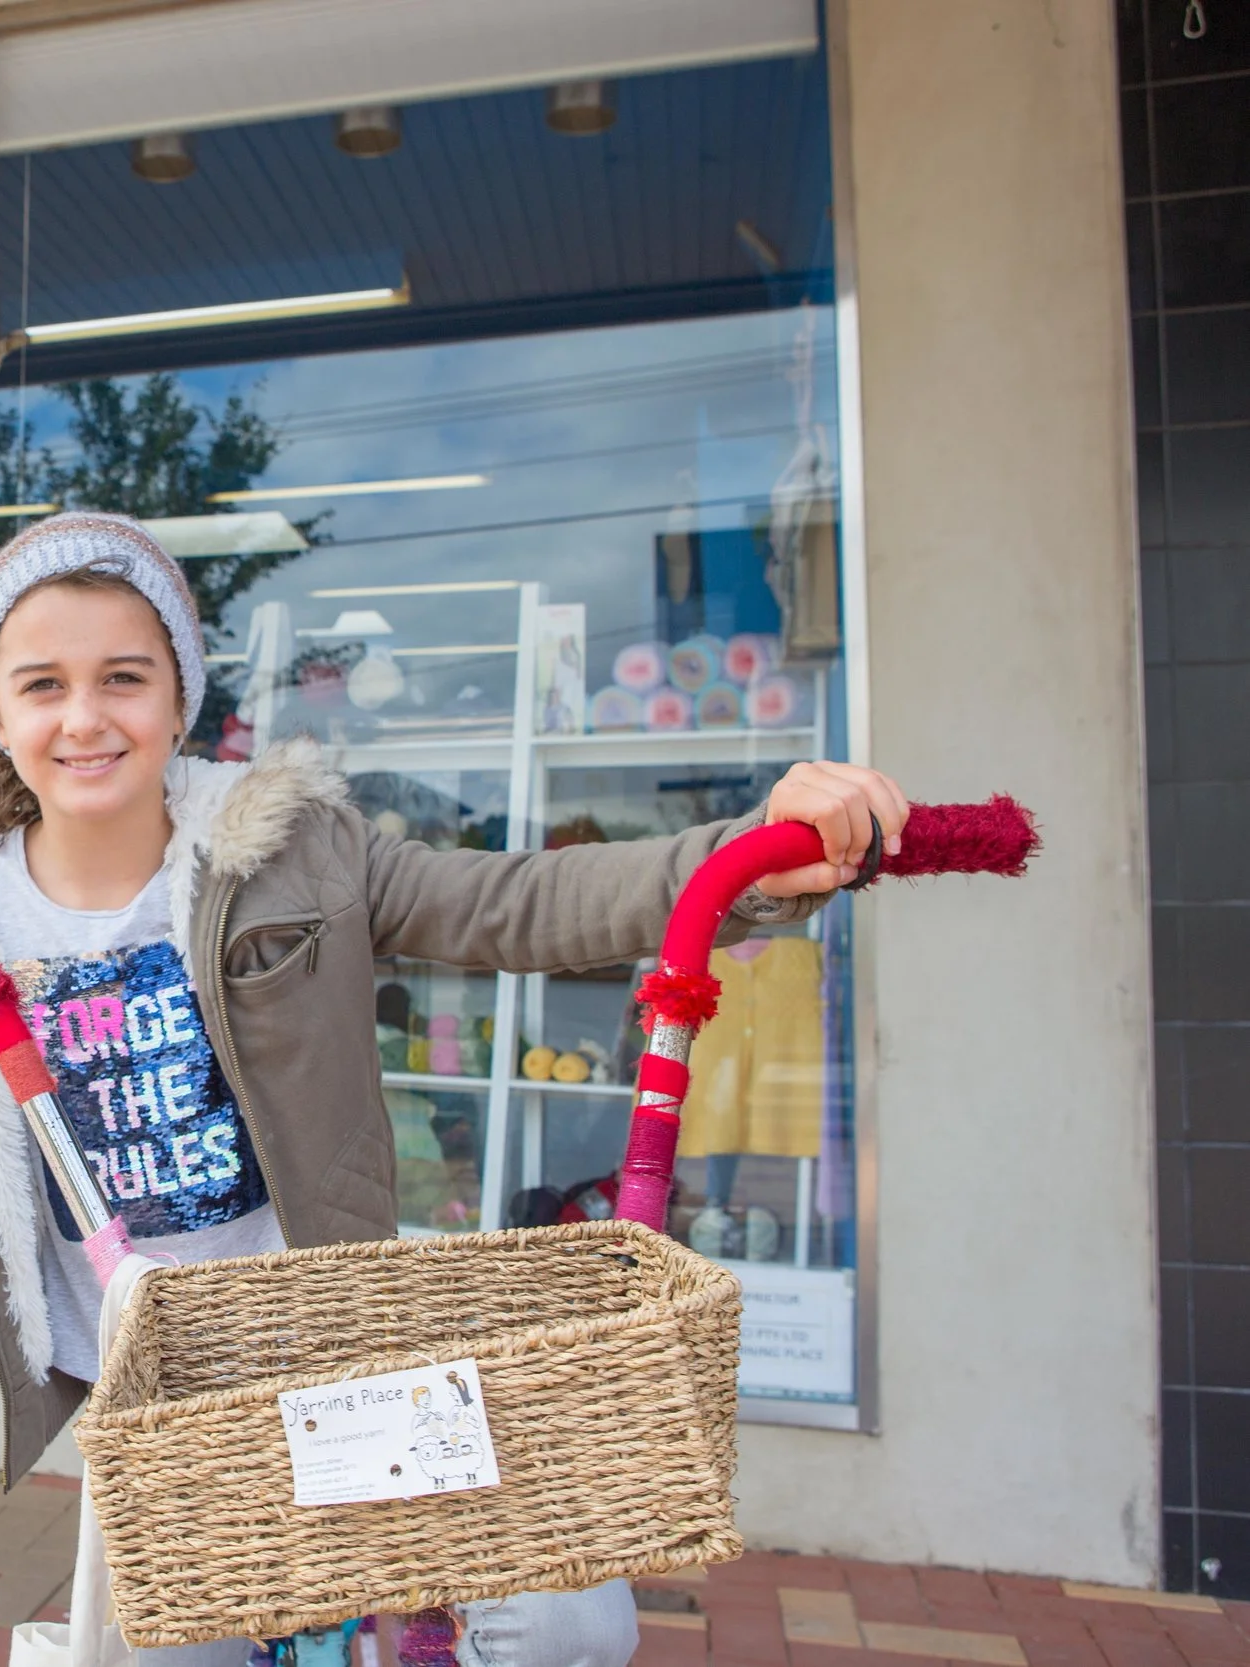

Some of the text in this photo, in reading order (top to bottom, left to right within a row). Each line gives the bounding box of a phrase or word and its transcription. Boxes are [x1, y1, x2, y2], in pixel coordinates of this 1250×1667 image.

[88, 1063, 197, 1131] THE
[283, 1388, 404, 1427] Yarning Place
[340, 1431, 363, 1445] good
